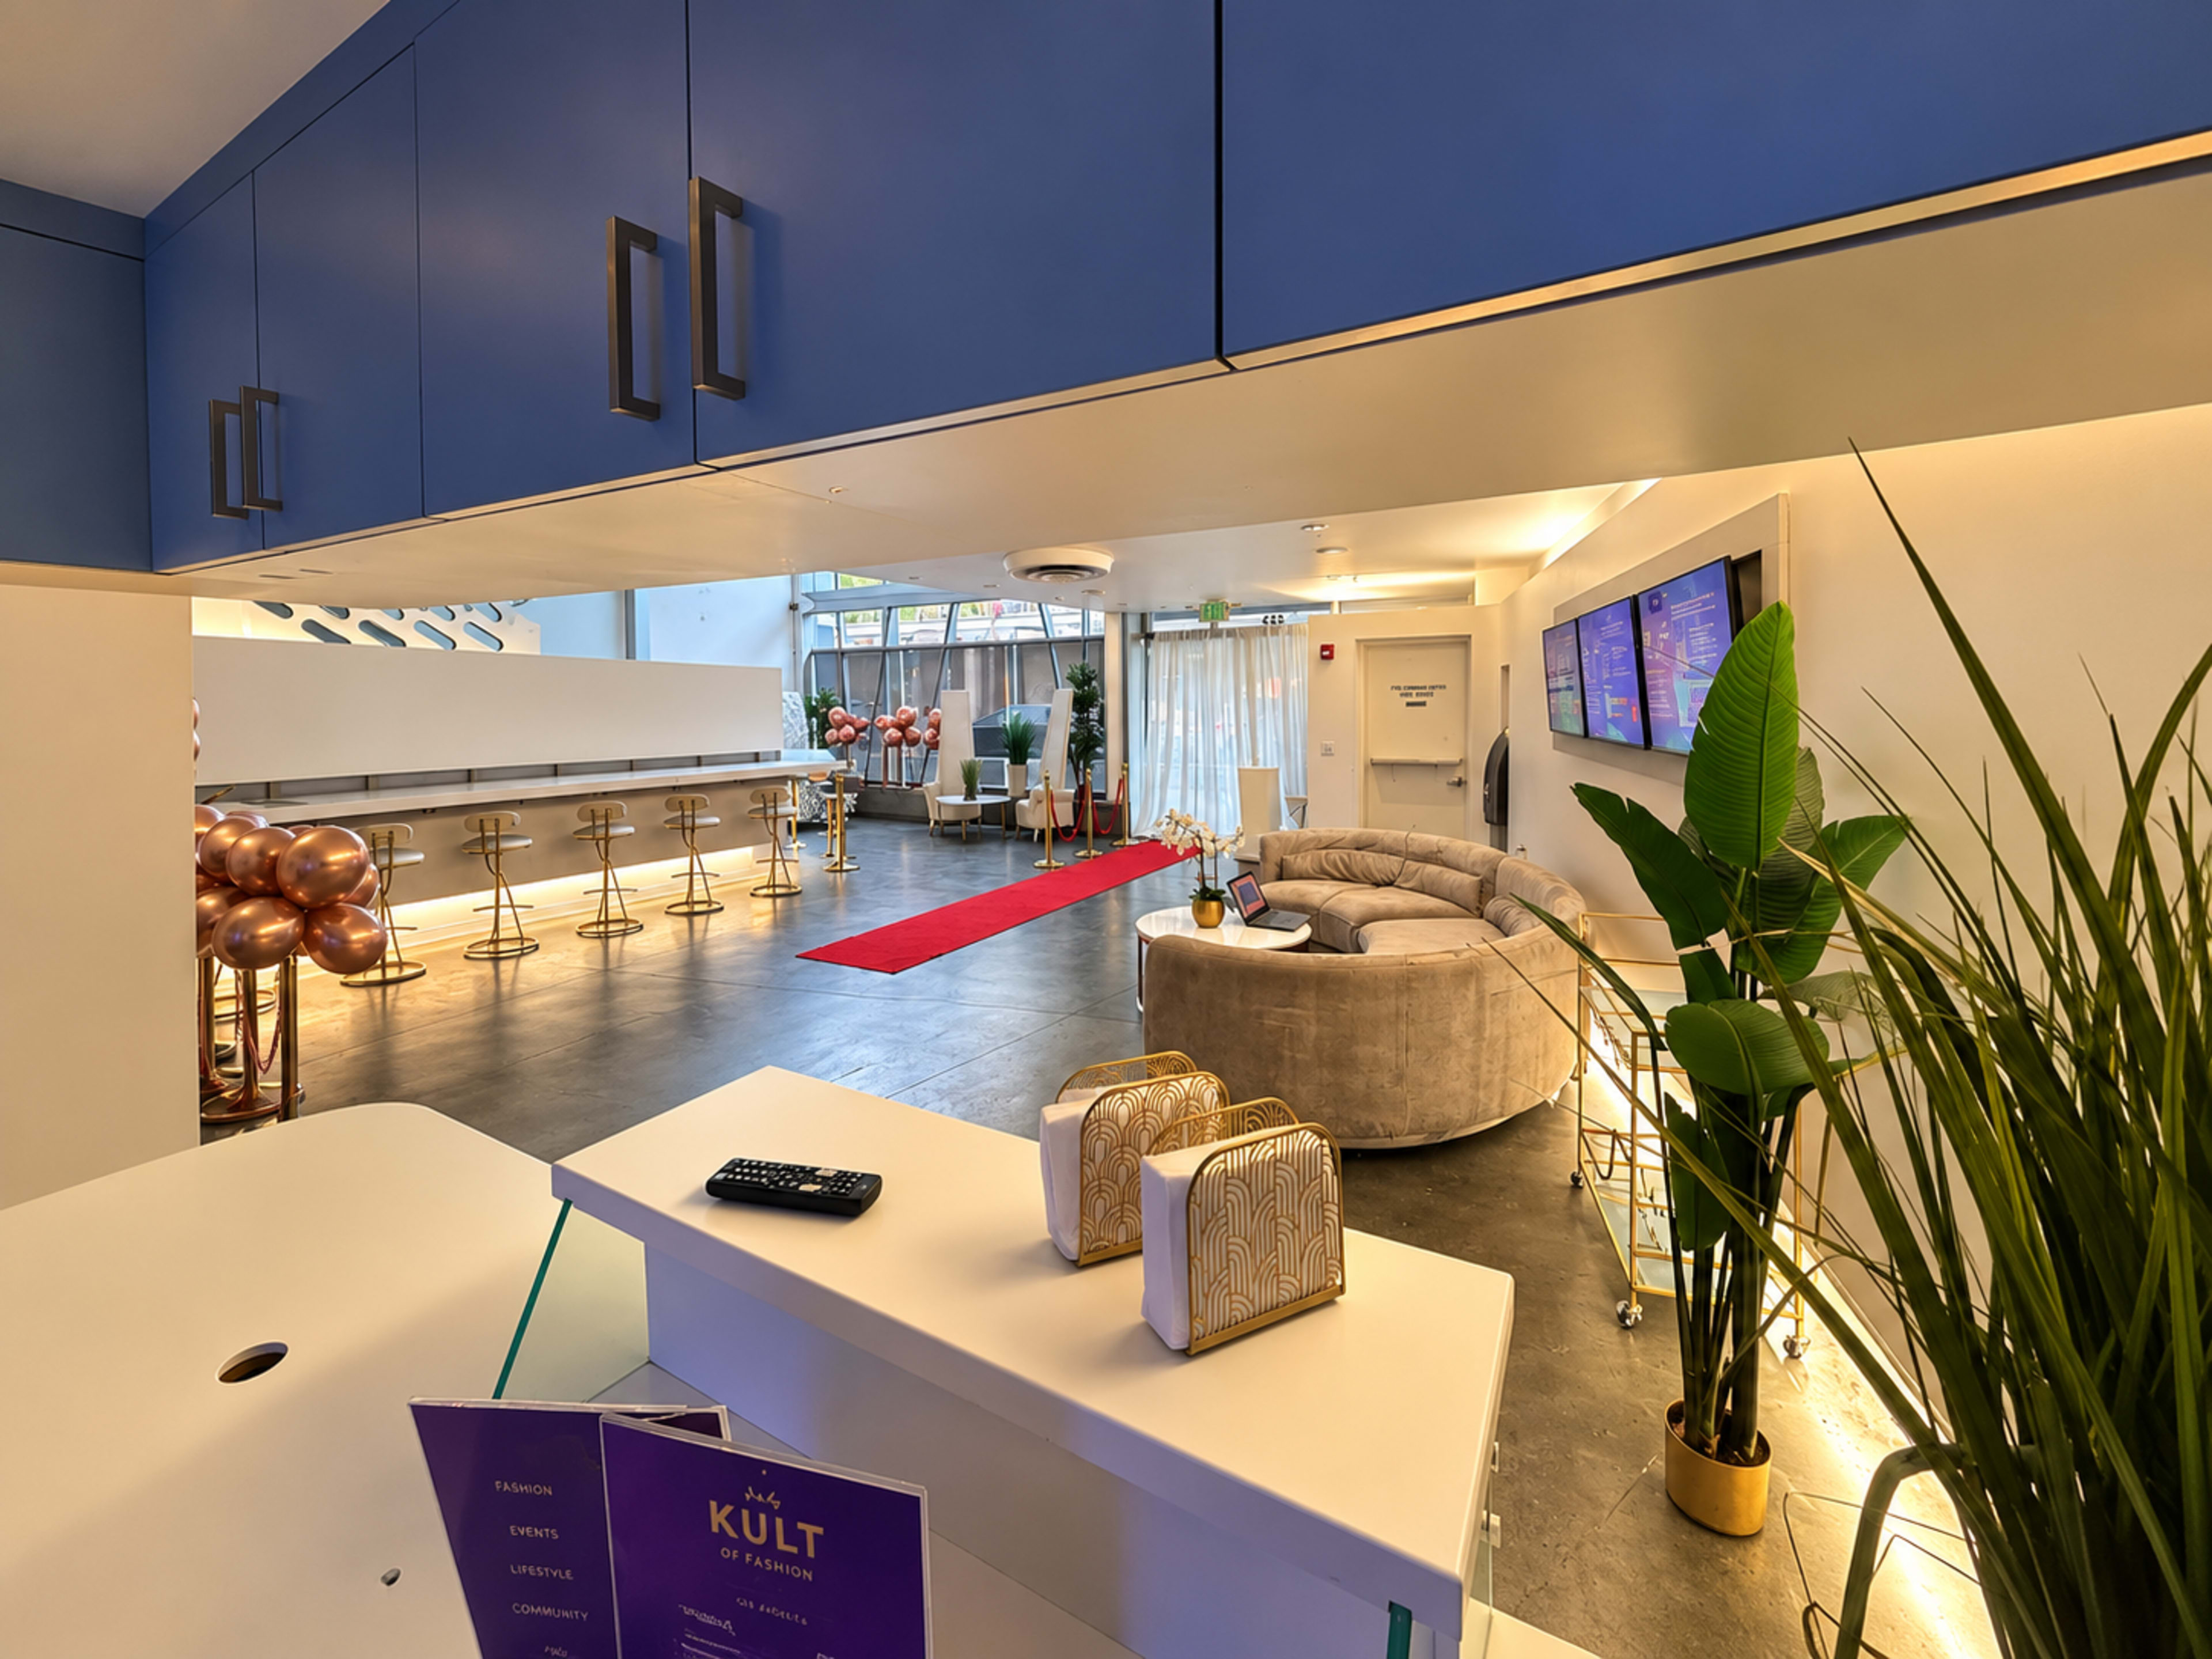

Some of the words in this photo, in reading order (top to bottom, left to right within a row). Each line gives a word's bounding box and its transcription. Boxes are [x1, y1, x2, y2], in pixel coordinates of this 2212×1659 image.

[495, 1480, 553, 1496] FASHION
[510, 1525, 559, 1540] EVENTS
[709, 1499, 824, 1559] KULT
[510, 1564, 574, 1580] LIFESTYLE
[721, 1547, 738, 1560] OF
[745, 1553, 813, 1581] FASHION
[512, 1603, 589, 1622] COMMUNITY
